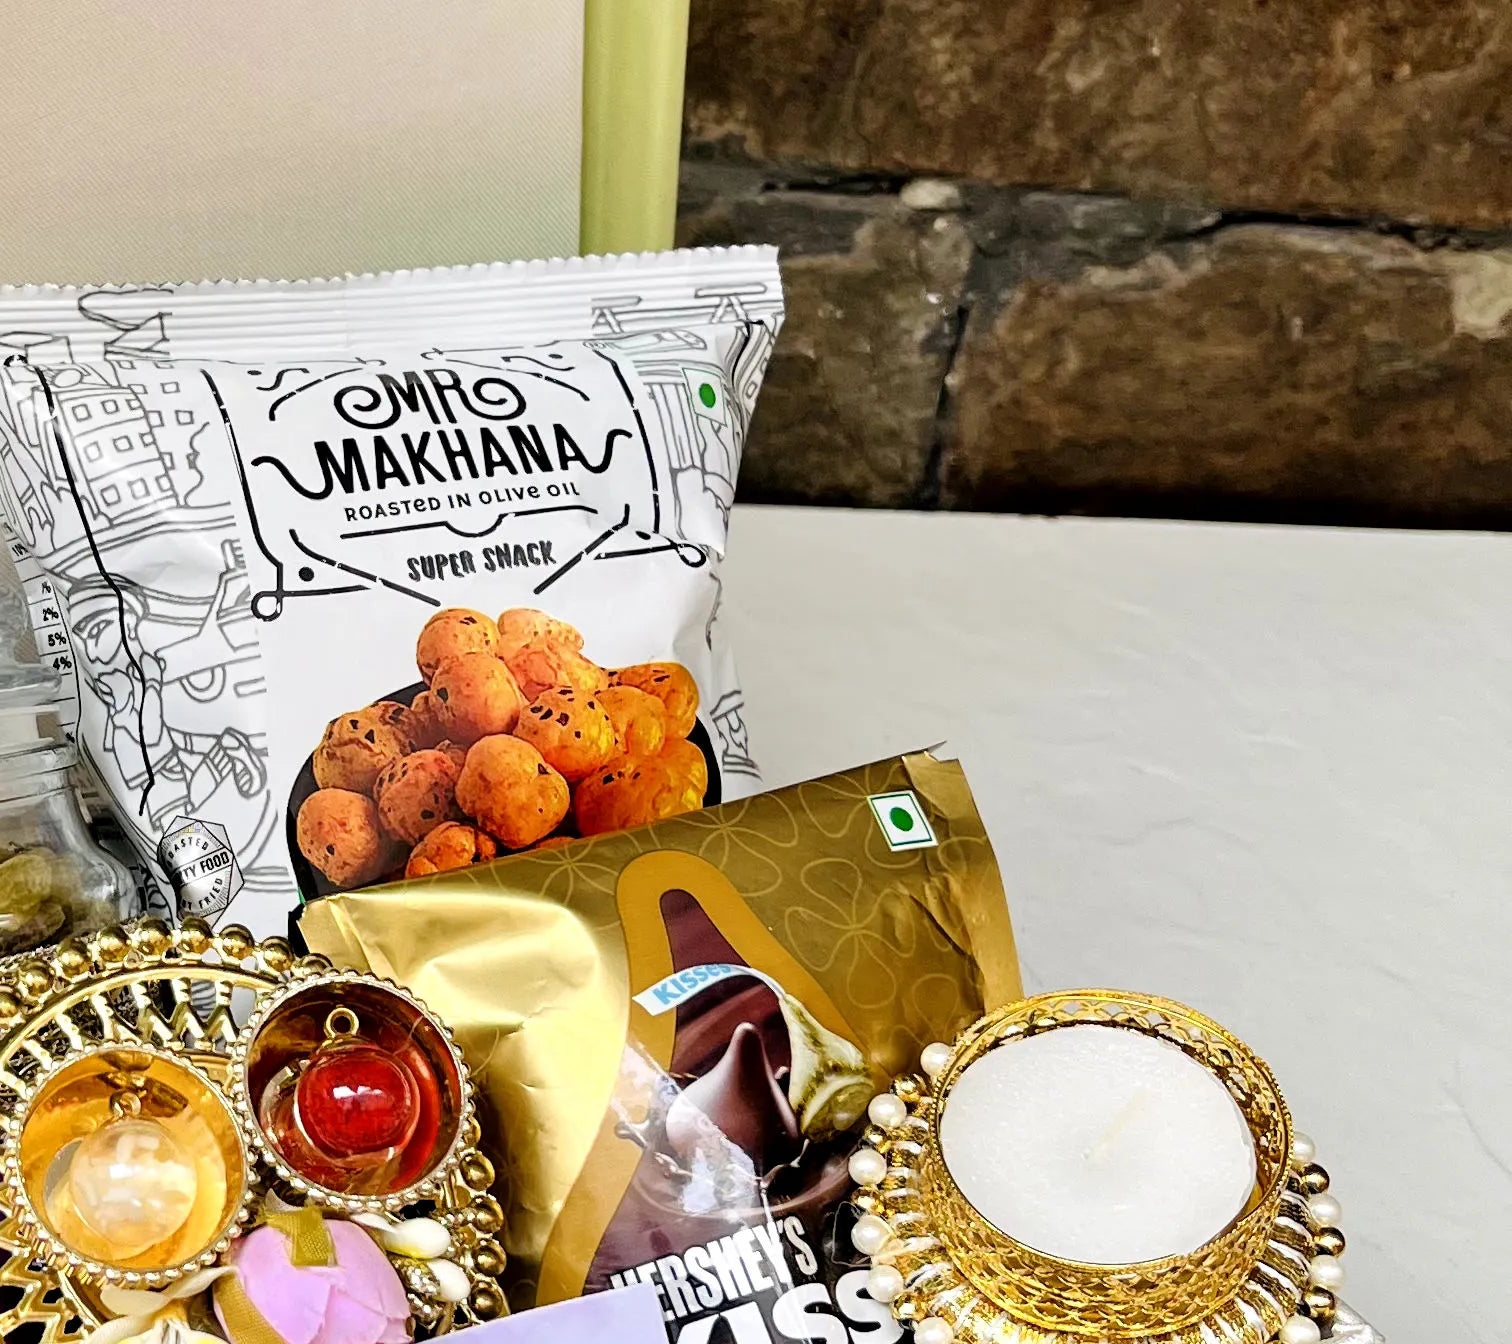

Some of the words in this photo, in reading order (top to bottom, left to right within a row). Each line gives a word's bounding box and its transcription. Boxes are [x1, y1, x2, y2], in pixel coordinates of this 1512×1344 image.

[334, 369, 527, 429] MR
[251, 423, 632, 500] MAKHANA
[447, 492, 471, 509] IN
[547, 481, 580, 498] OIL
[407, 548, 476, 582] SUPER
[484, 540, 556, 574] SNACK
[48, 632, 67, 647] 5%
[53, 656, 72, 671] 4%
[200, 851, 230, 874] FOOD
